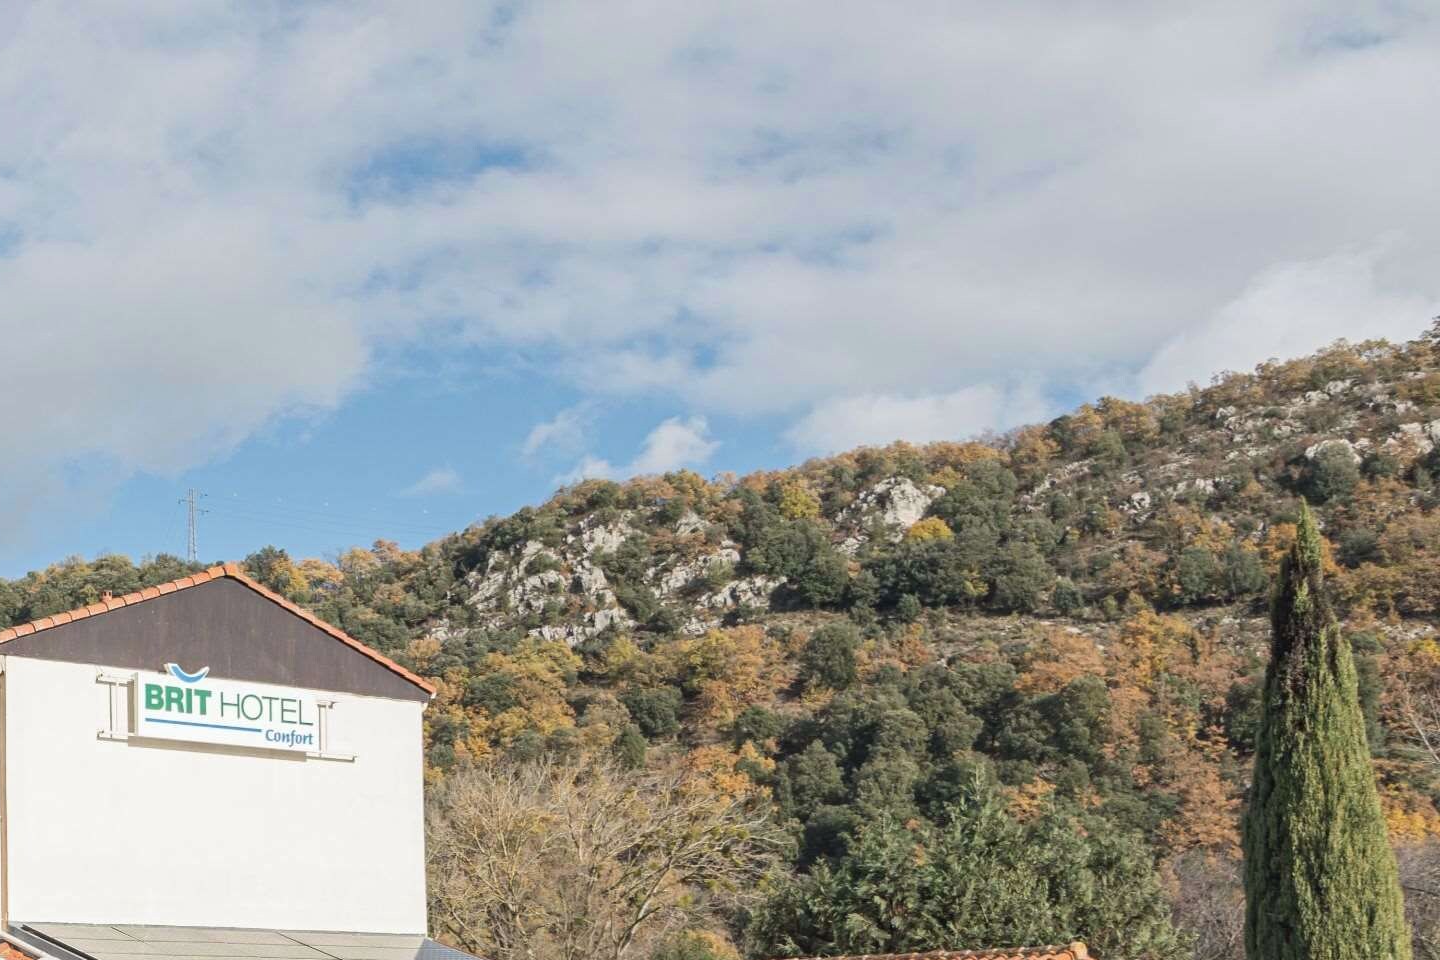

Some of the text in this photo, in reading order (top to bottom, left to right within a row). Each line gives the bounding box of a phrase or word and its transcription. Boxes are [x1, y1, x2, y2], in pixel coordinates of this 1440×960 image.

[144, 683, 314, 726] BRIT HOTEL
[265, 728, 313, 747] Confort
